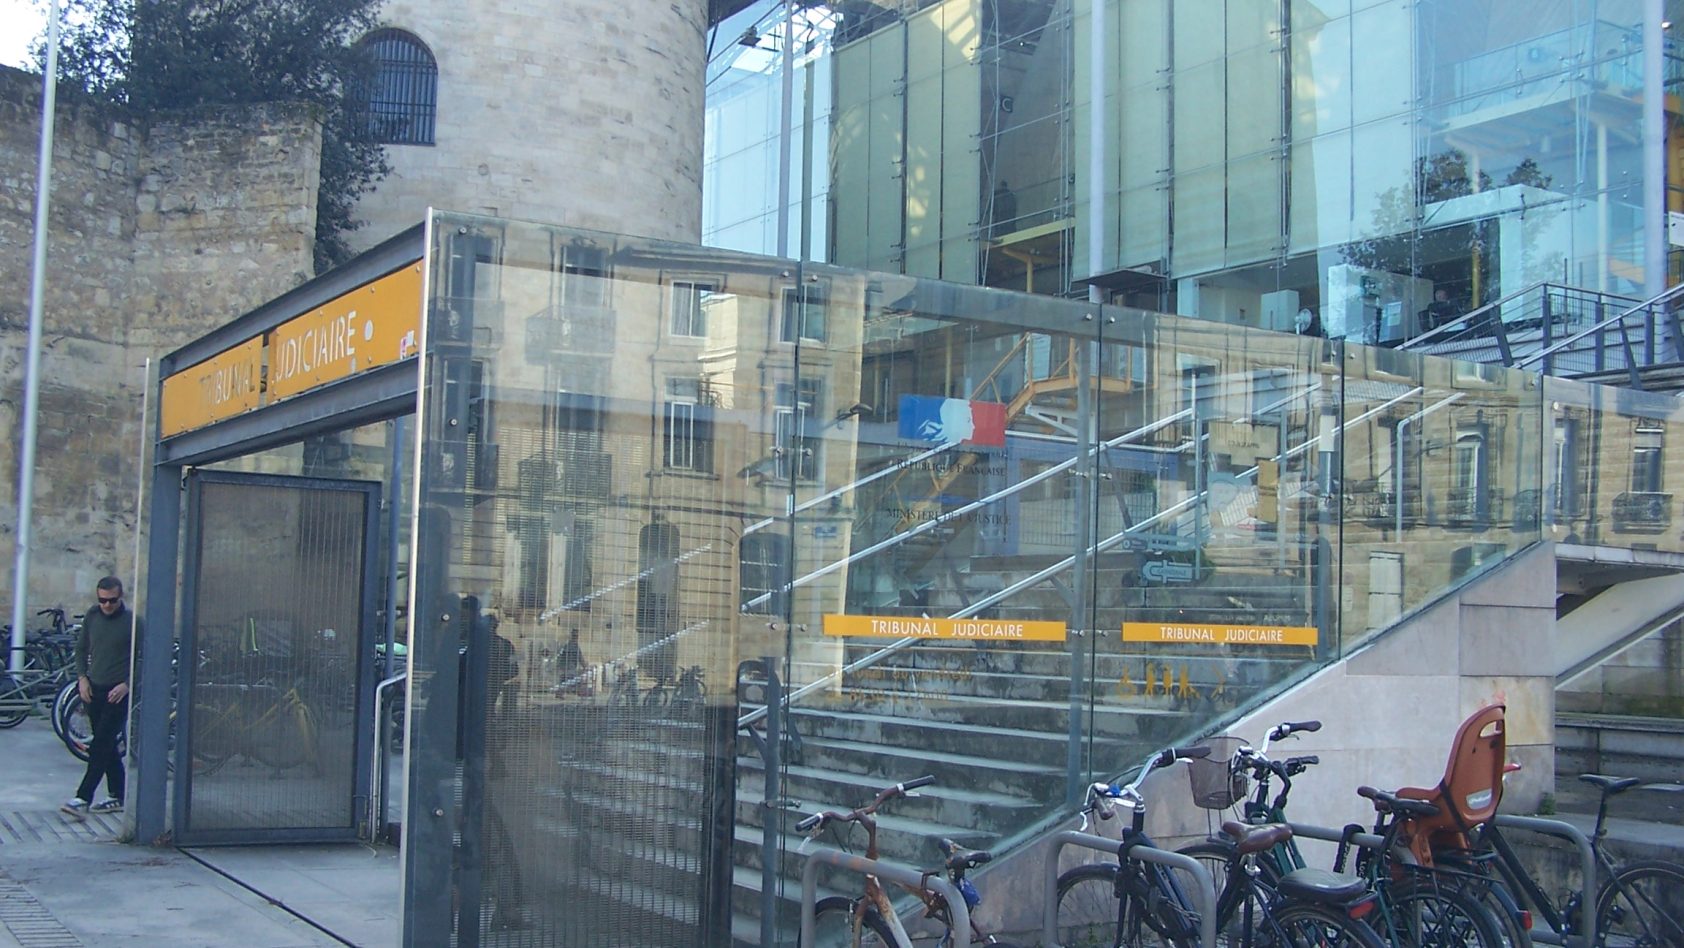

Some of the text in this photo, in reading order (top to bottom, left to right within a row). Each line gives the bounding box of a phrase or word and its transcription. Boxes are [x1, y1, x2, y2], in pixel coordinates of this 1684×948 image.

[274, 311, 356, 383] JUDICIAIRE
[898, 458, 954, 474] RPUBLIQUE
[872, 620, 1024, 637] TRIBUNAL JUDICIAIRE
[1160, 626, 1283, 642] TRIBUNAL JUDICIAIRE
